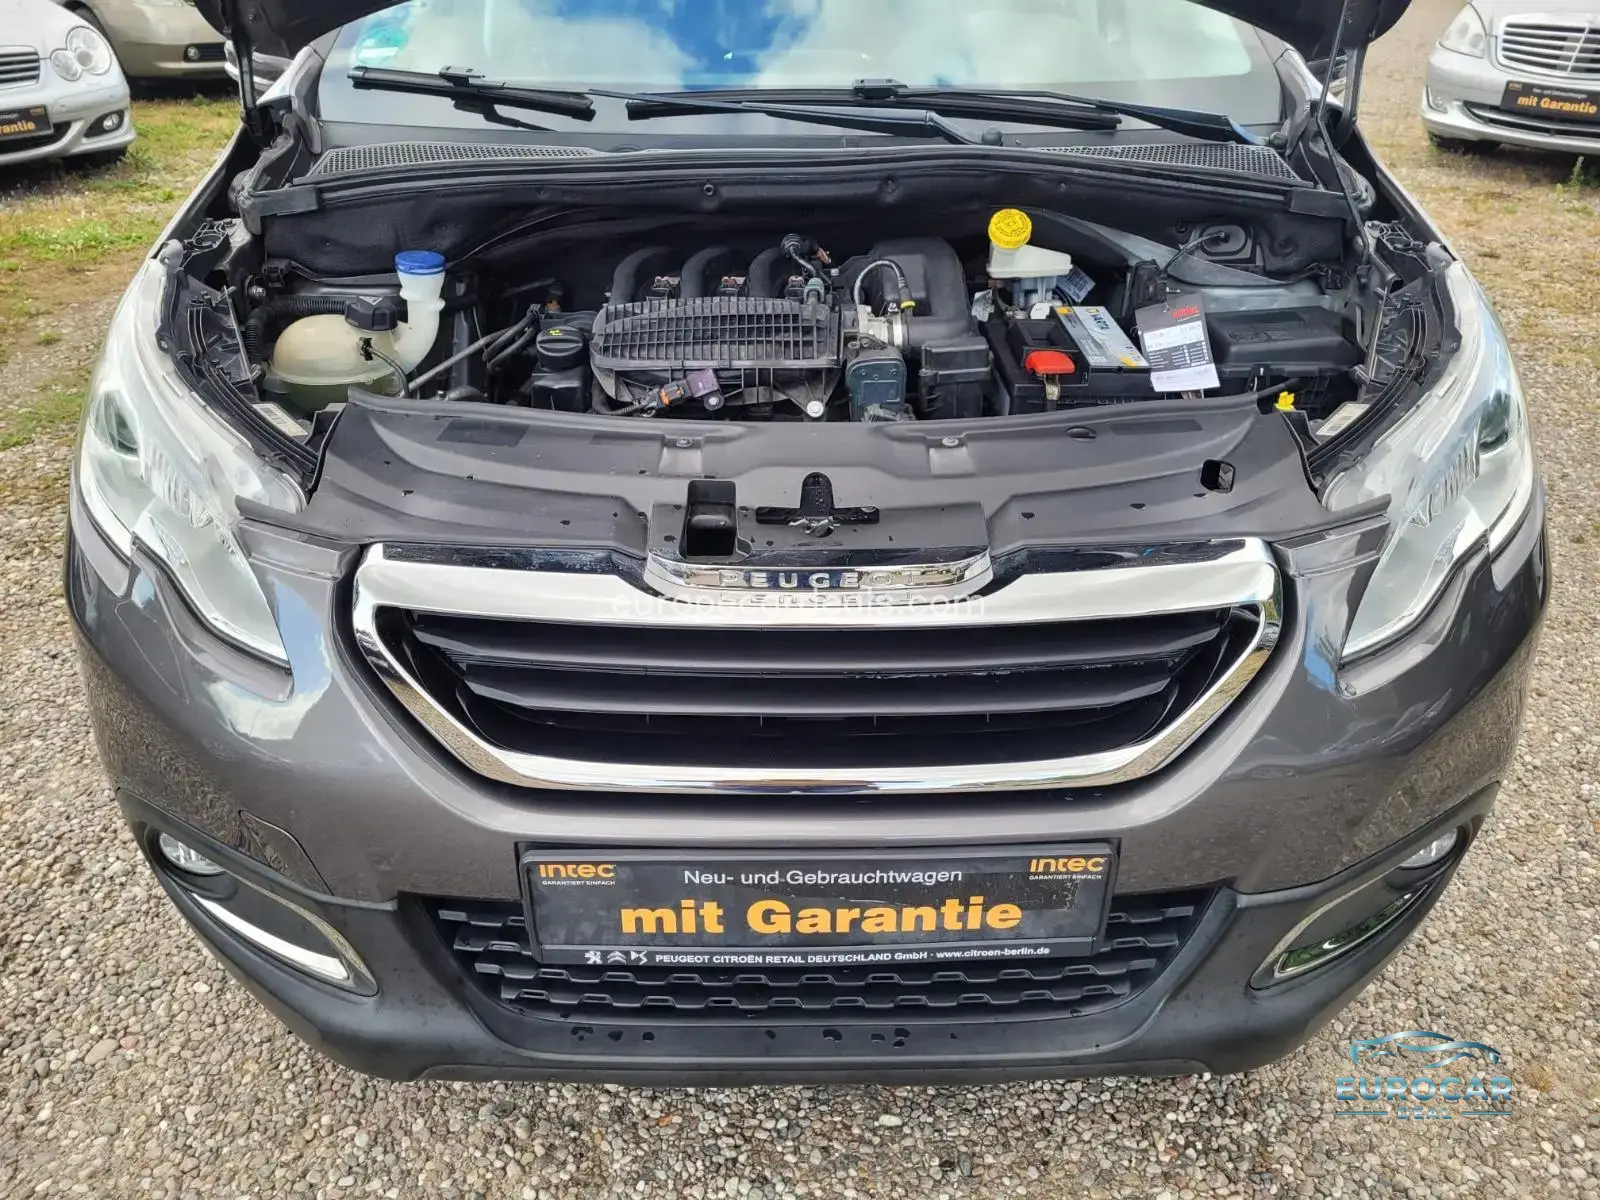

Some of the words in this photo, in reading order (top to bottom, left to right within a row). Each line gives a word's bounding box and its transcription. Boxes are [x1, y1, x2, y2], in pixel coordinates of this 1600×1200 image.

[1517, 95, 1538, 107] mit
[1540, 97, 1598, 114] Garantie
[719, 569, 921, 589] PEUGEOT
[684, 870, 734, 885] Neu-
[741, 870, 779, 885] und
[786, 869, 962, 886] Gebrauchtwagen
[620, 899, 724, 934] mit
[746, 895, 1022, 934] Garantie
[655, 954, 710, 964] PEUGEOT
[712, 952, 764, 964] CITROËN
[765, 954, 805, 964] RETAIL
[807, 952, 892, 964] DEUTSCHLAND
[894, 951, 928, 961] GmbH
[936, 946, 1050, 959] www.citroen-berlin.de
